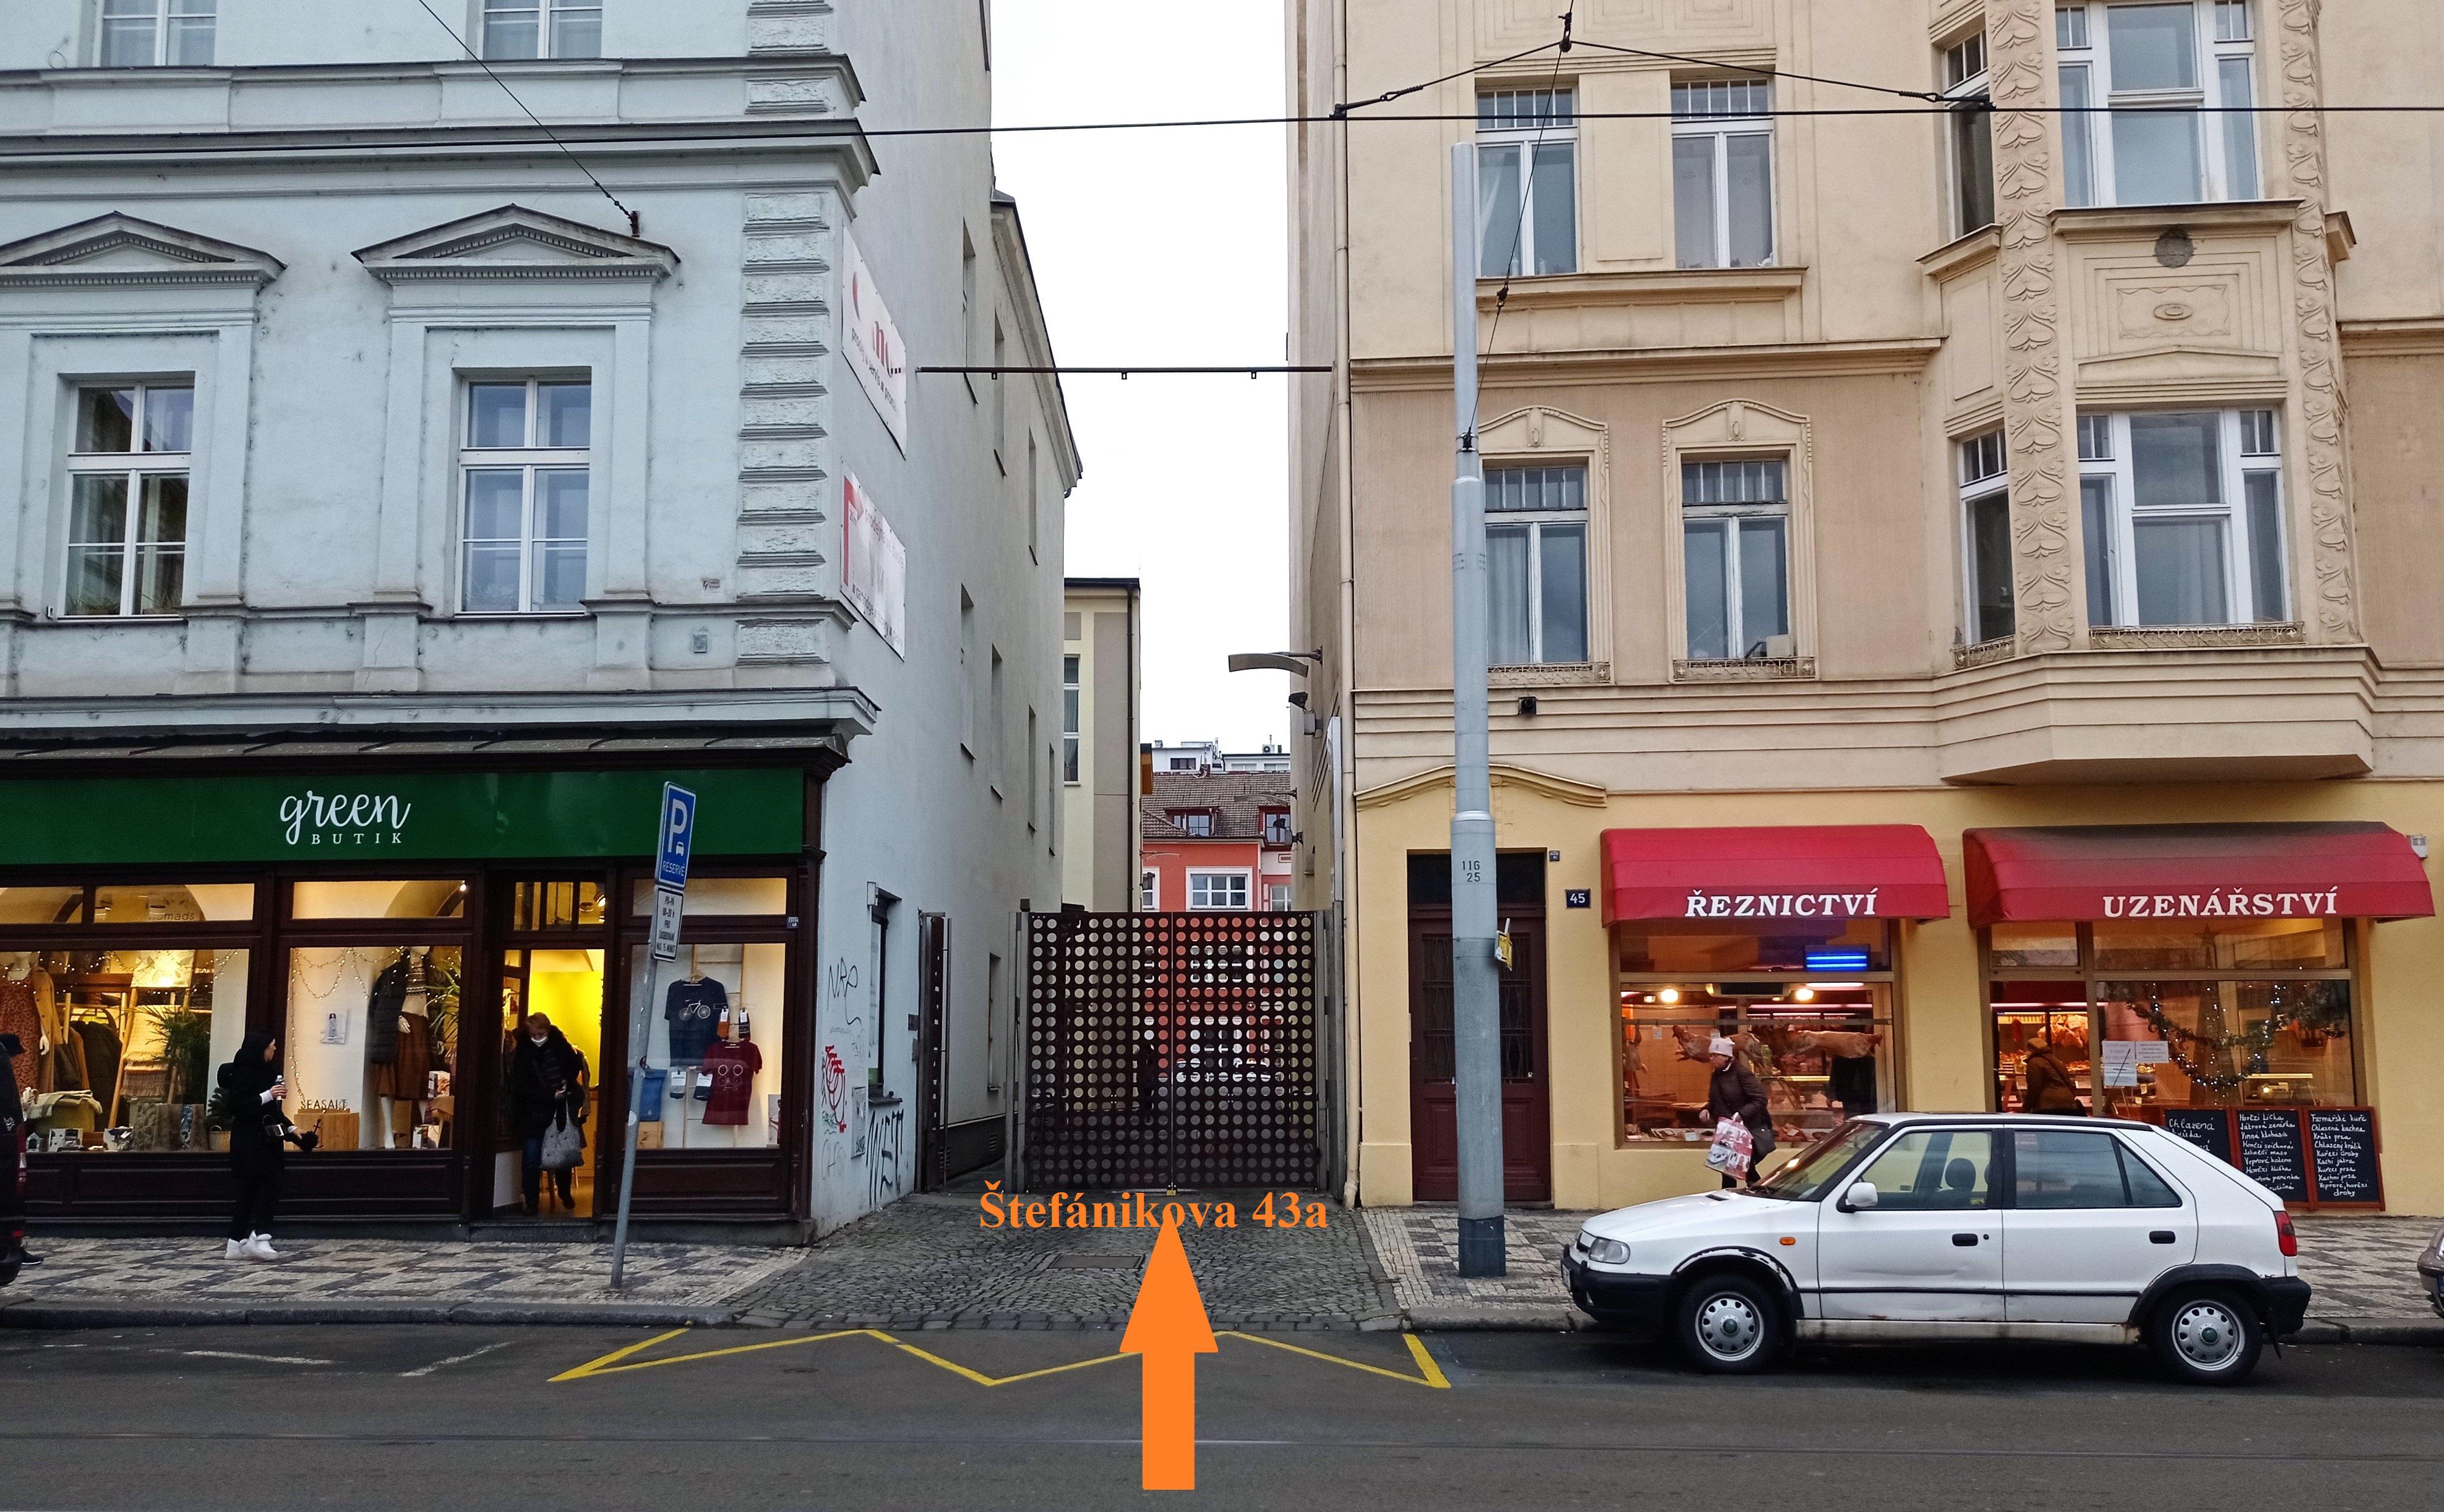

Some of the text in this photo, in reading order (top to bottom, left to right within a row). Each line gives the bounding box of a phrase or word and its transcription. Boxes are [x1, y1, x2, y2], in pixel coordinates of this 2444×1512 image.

[280, 790, 411, 845] green
[668, 799, 687, 853] P
[311, 833, 401, 844] BUTIK
[662, 859, 686, 876] RÉSERVÉ
[1467, 872, 1480, 882] 25
[1569, 893, 1585, 903] 45
[1684, 887, 1879, 916] ŘEZNICTVÍ
[2103, 886, 2338, 917] UZENÁŘSTVÍ
[301, 1099, 348, 1109] SEASALT
[2169, 1117, 2215, 1130] Chlazená
[2341, 1124, 2365, 1132] kachna
[2333, 1189, 2356, 1197] droby
